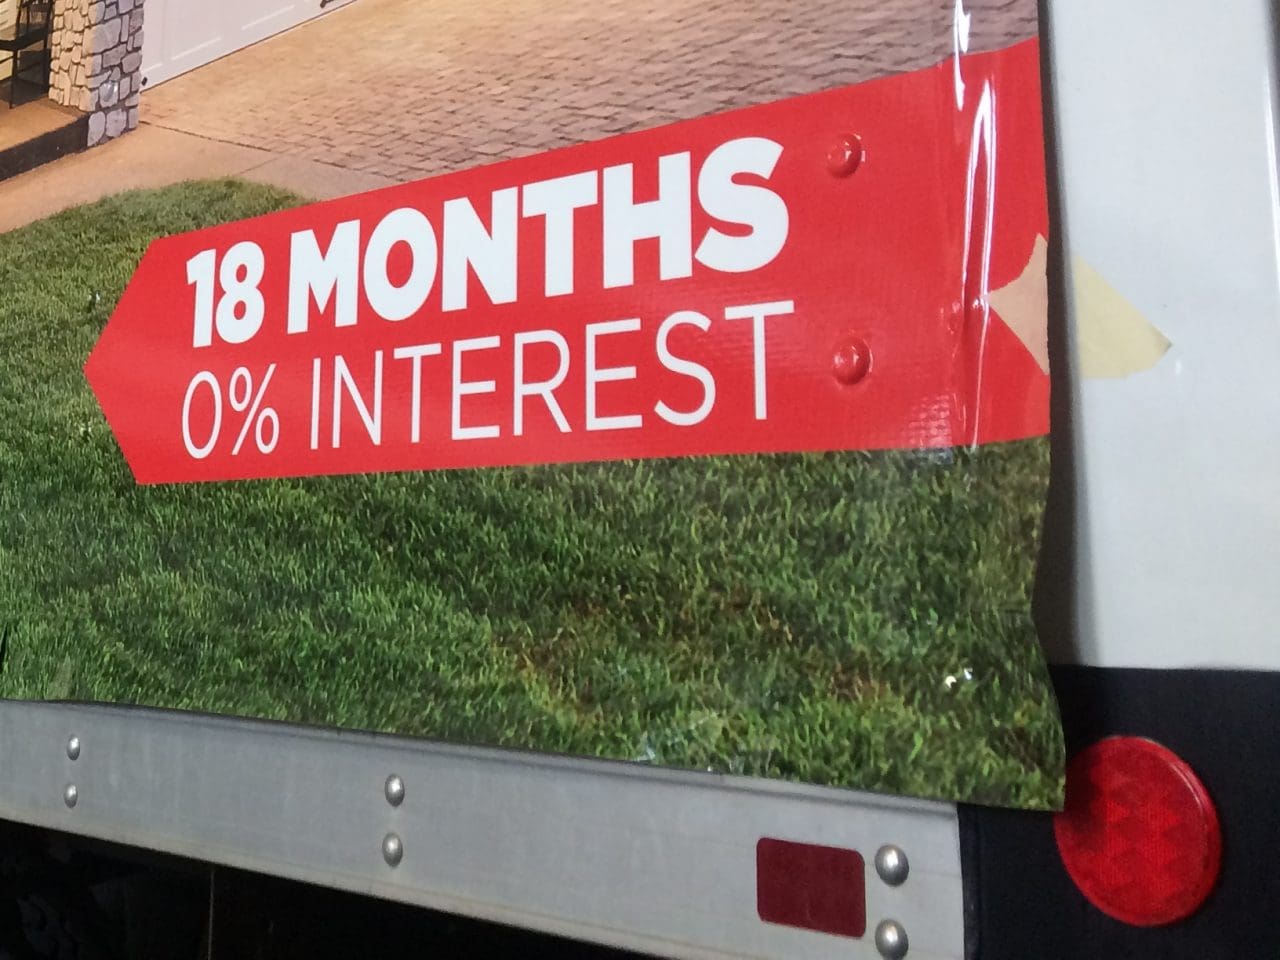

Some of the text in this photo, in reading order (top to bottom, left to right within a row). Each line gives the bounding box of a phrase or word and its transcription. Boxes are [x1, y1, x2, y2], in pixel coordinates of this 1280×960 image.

[186, 137, 790, 348] 18 MONTHS
[181, 300, 794, 459] 0% INTEREST
